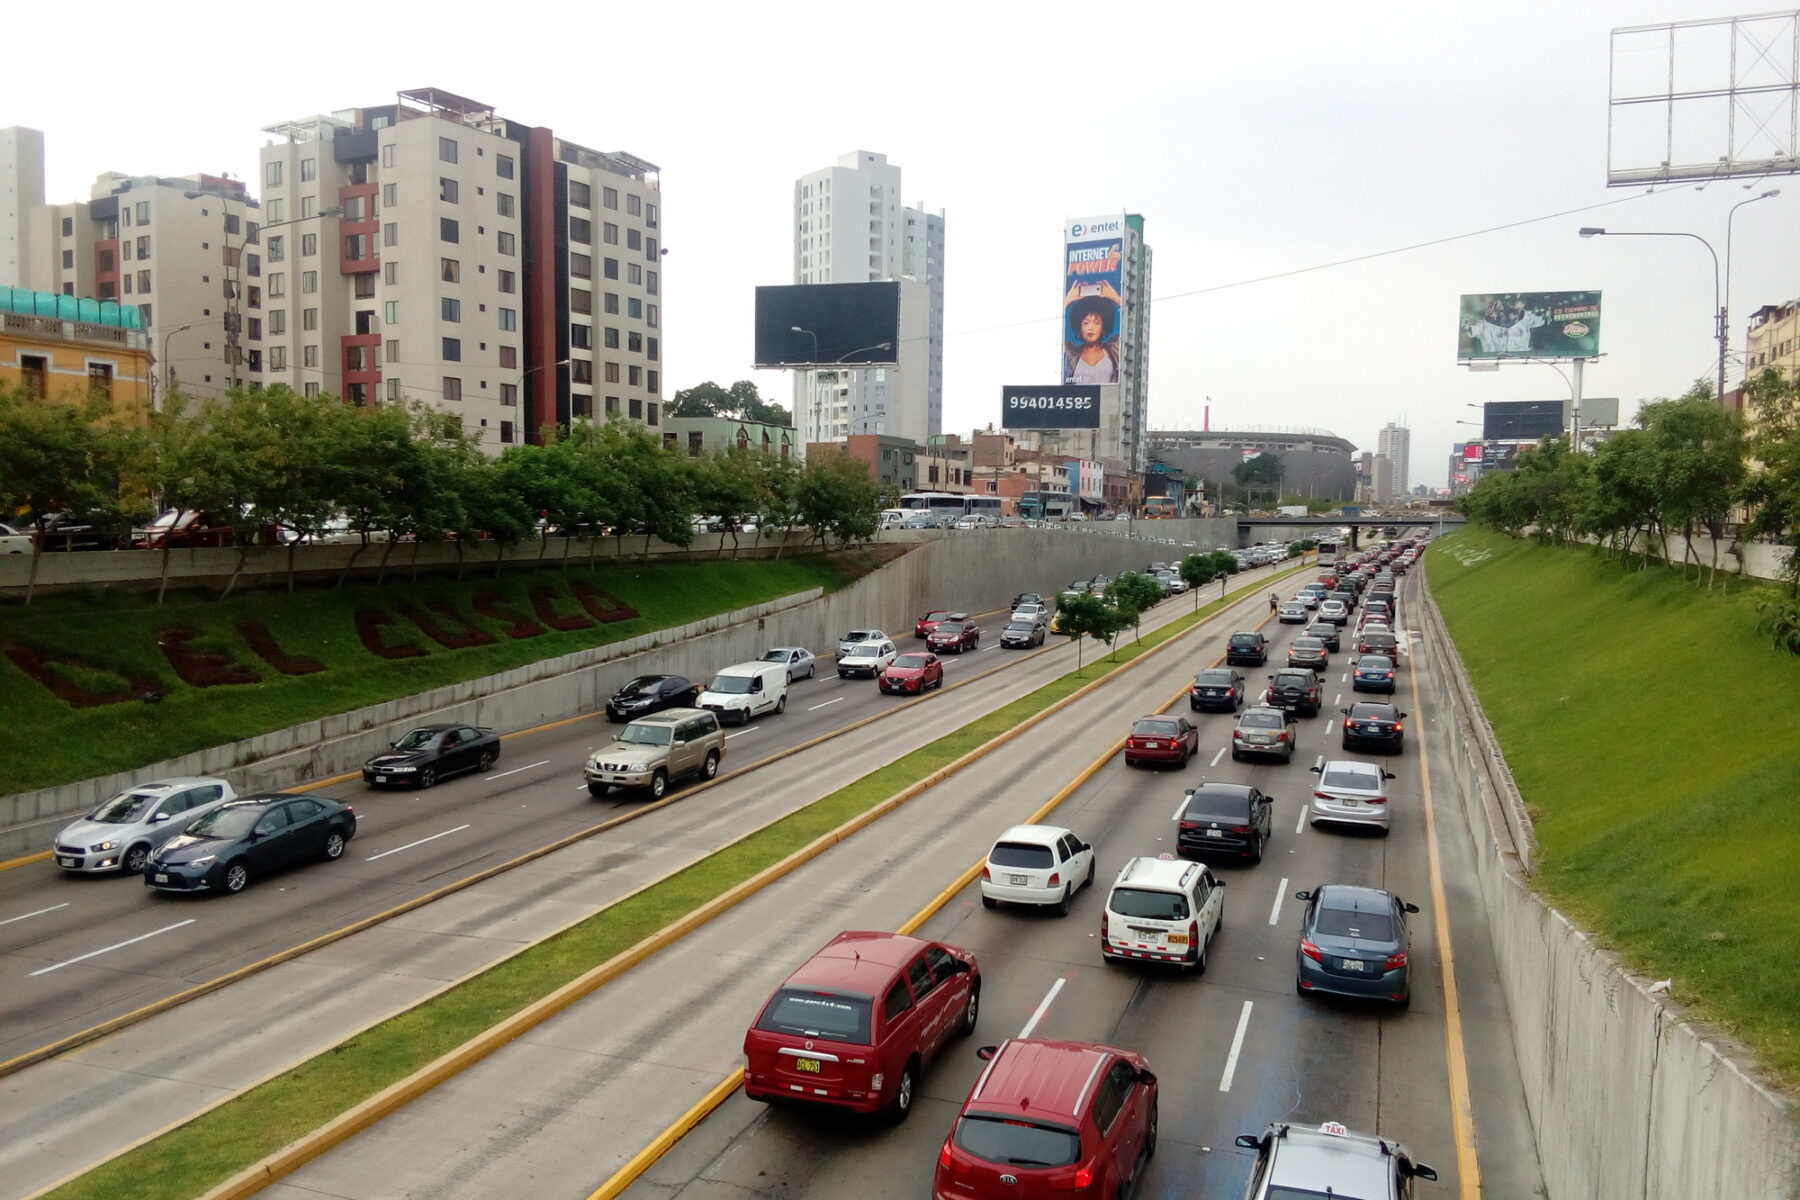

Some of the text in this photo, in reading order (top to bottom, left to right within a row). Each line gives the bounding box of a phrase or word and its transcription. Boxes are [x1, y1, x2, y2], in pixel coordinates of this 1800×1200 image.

[1091, 221, 1118, 233] entel
[1069, 247, 1109, 262] INTERNET
[1068, 259, 1118, 275] POWER
[1010, 396, 1092, 409] 994014585
[353, 580, 641, 659] CUSCO
[1326, 1125, 1345, 1135] TAXI
